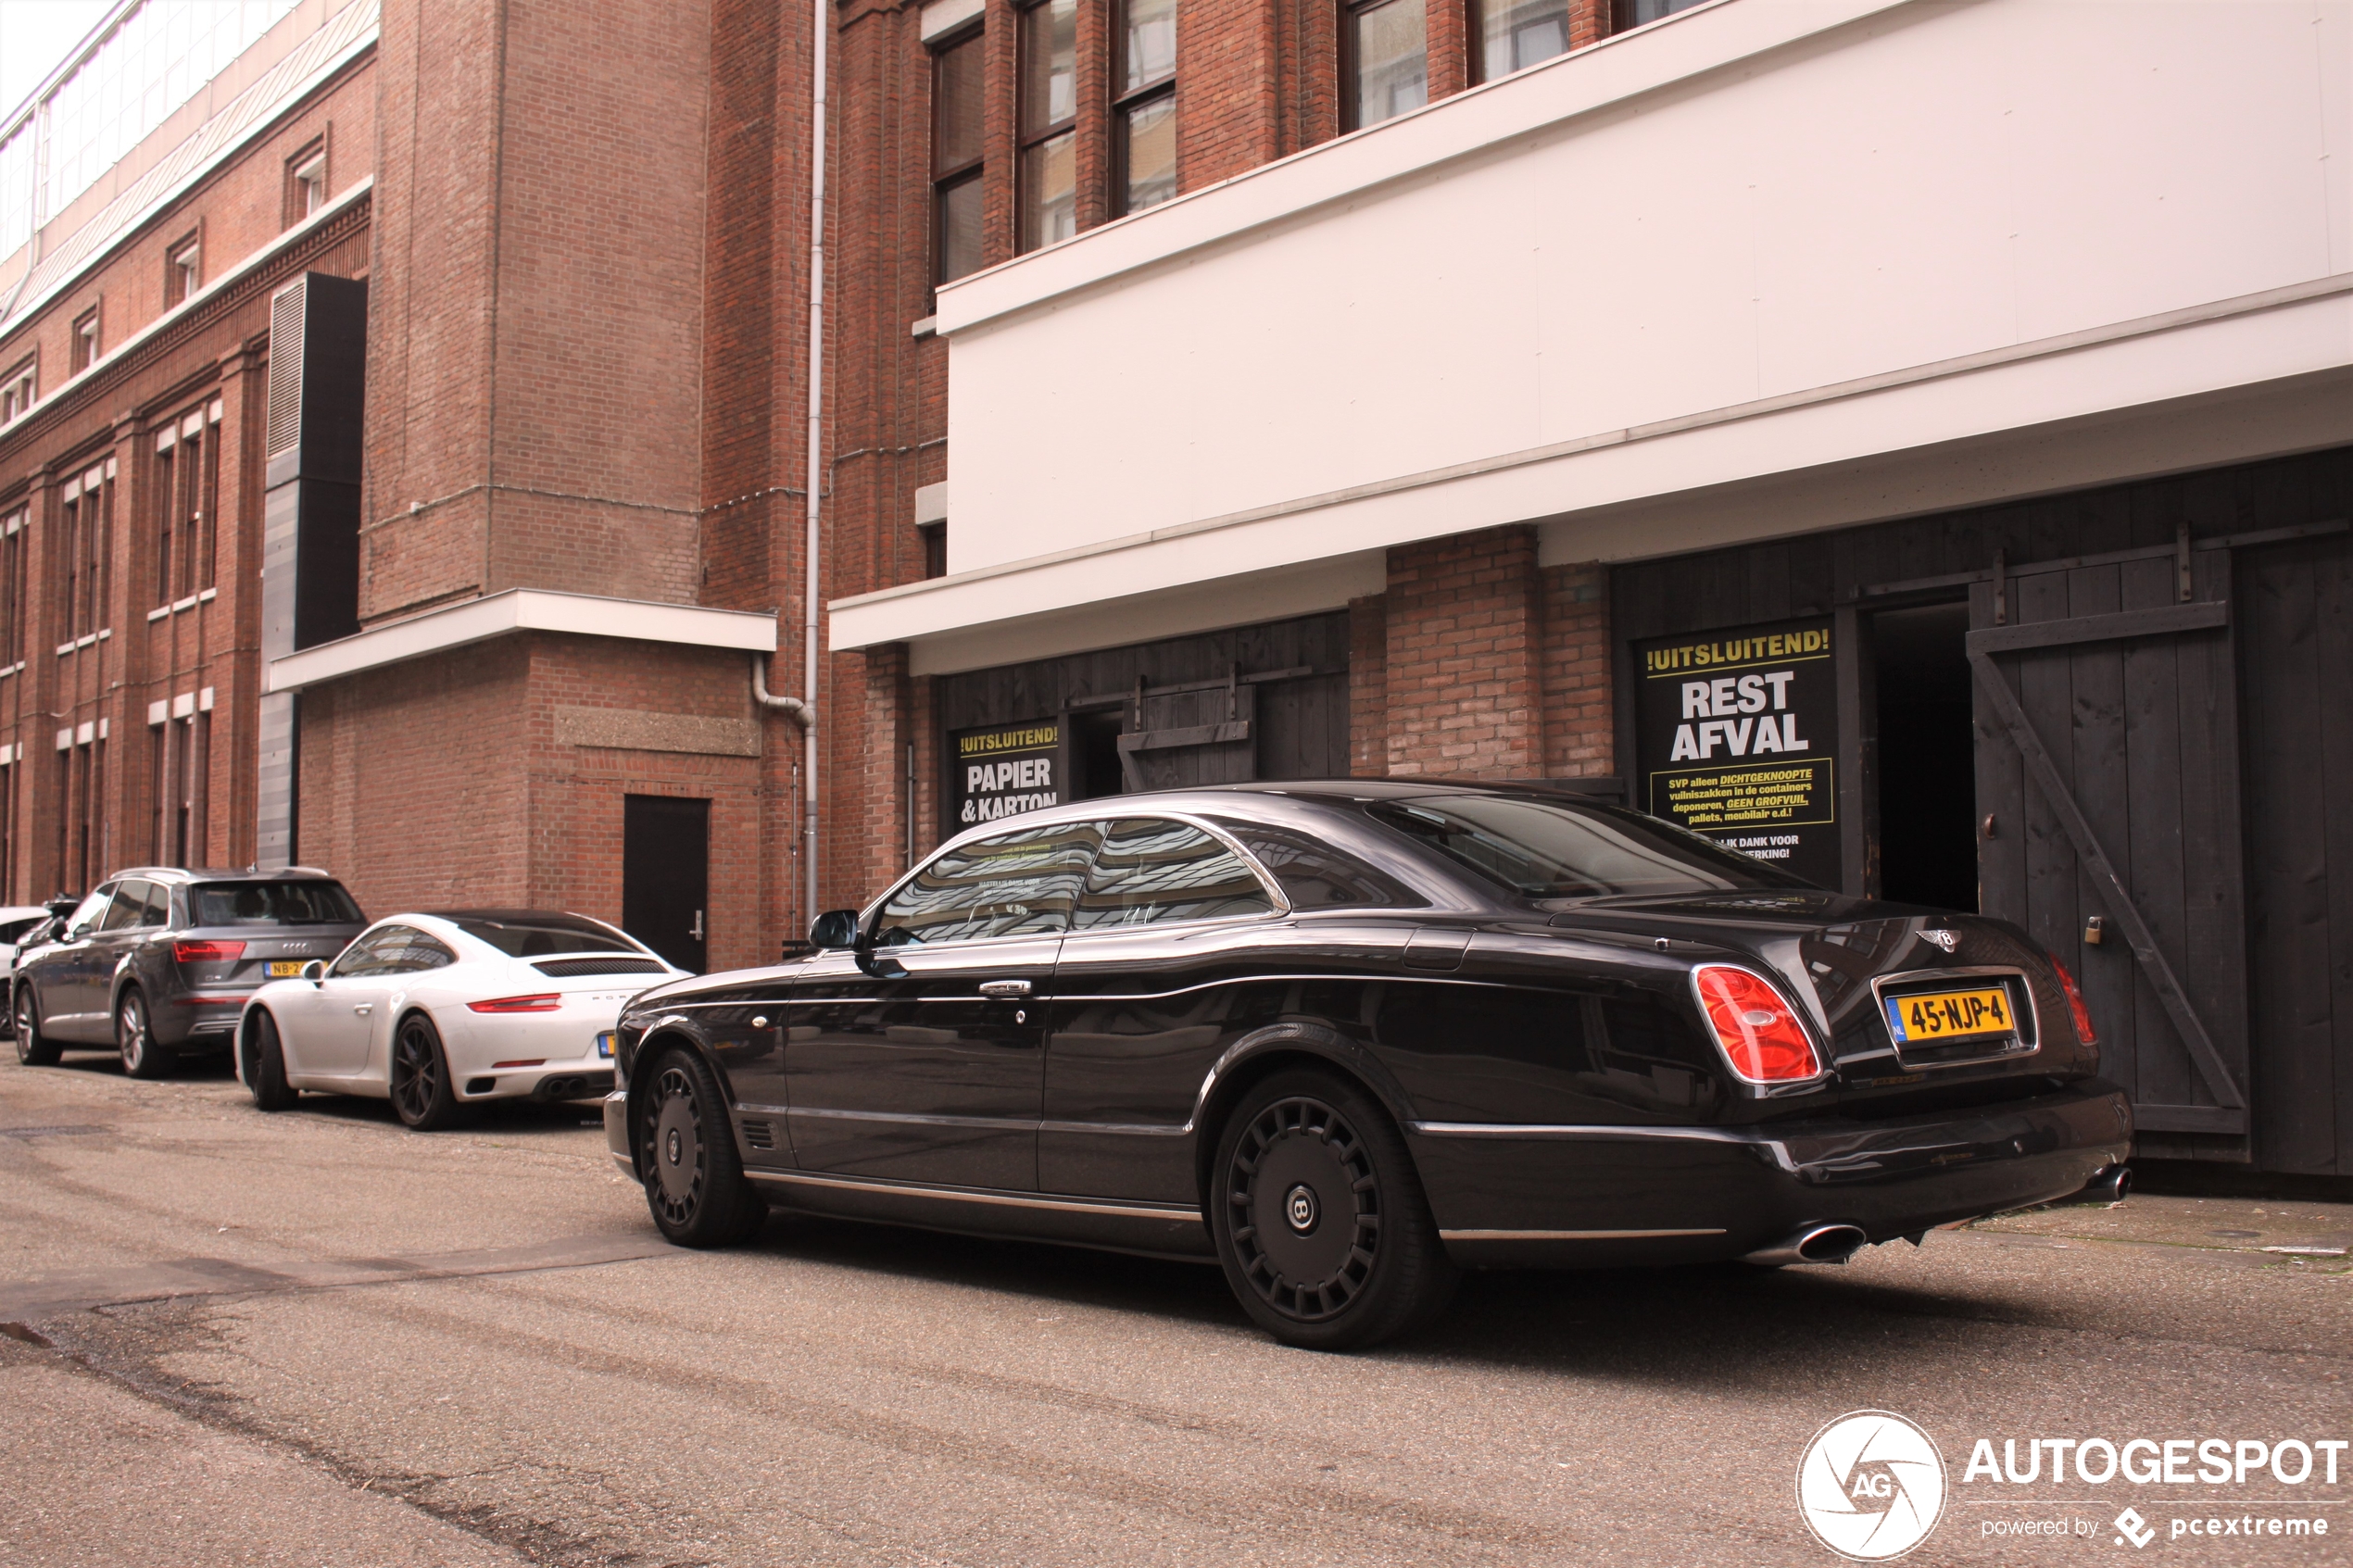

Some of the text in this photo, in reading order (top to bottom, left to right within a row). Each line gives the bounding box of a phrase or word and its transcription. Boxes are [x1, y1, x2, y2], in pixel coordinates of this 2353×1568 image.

[1647, 629, 1829, 671] !UITSLUITEND!
[1682, 671, 1793, 719] REST
[961, 726, 1058, 752] !UITSLUITEND!
[1670, 713, 1809, 761] AFVAL
[967, 758, 1051, 793] PAPIER
[1668, 769, 1812, 789] SVP alleen DICHTGEKNOOPTE
[1669, 783, 1812, 800] vuilniszakken in de containers
[961, 799, 975, 822] &
[1673, 795, 1809, 812] deponeren, GEEN GROFVUIL,
[1689, 808, 1793, 825] pallets, meubilair e.d.!
[1739, 836, 1768, 847] DANK
[1769, 834, 1799, 846] VOOR
[1911, 995, 2004, 1034] 45-NJP-4
[1892, 1025, 1905, 1035] NL
